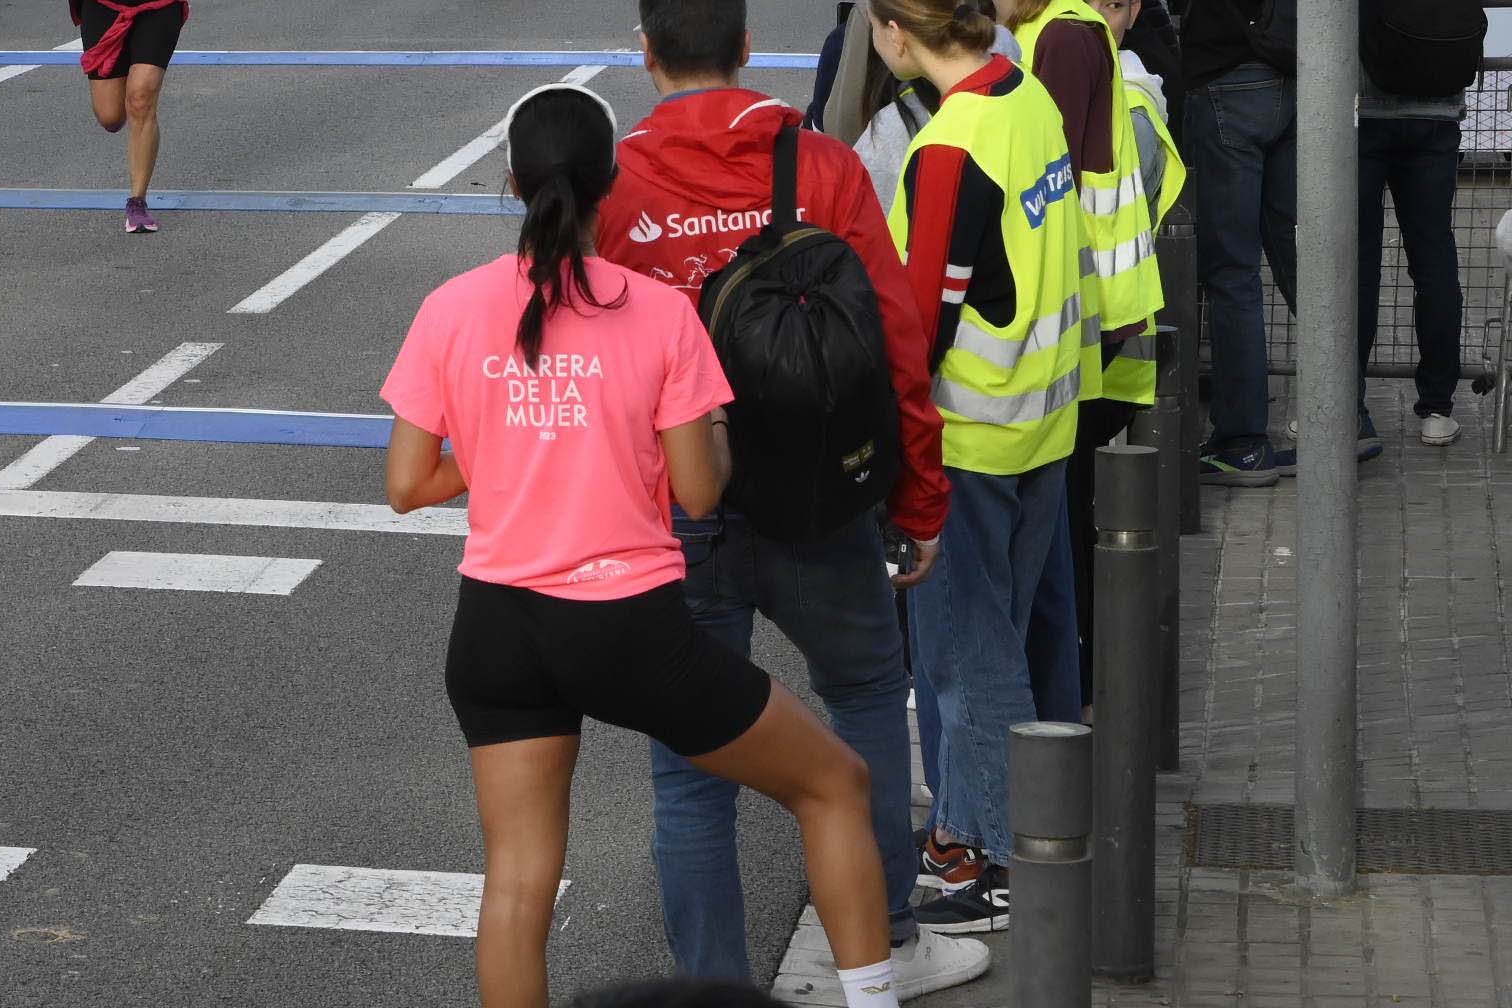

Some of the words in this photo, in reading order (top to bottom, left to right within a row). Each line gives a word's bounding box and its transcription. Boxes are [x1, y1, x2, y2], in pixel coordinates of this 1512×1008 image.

[666, 207, 806, 238] Santanr
[508, 380, 540, 402] DE
[551, 379, 583, 402] LA
[506, 404, 588, 427] MUJER
